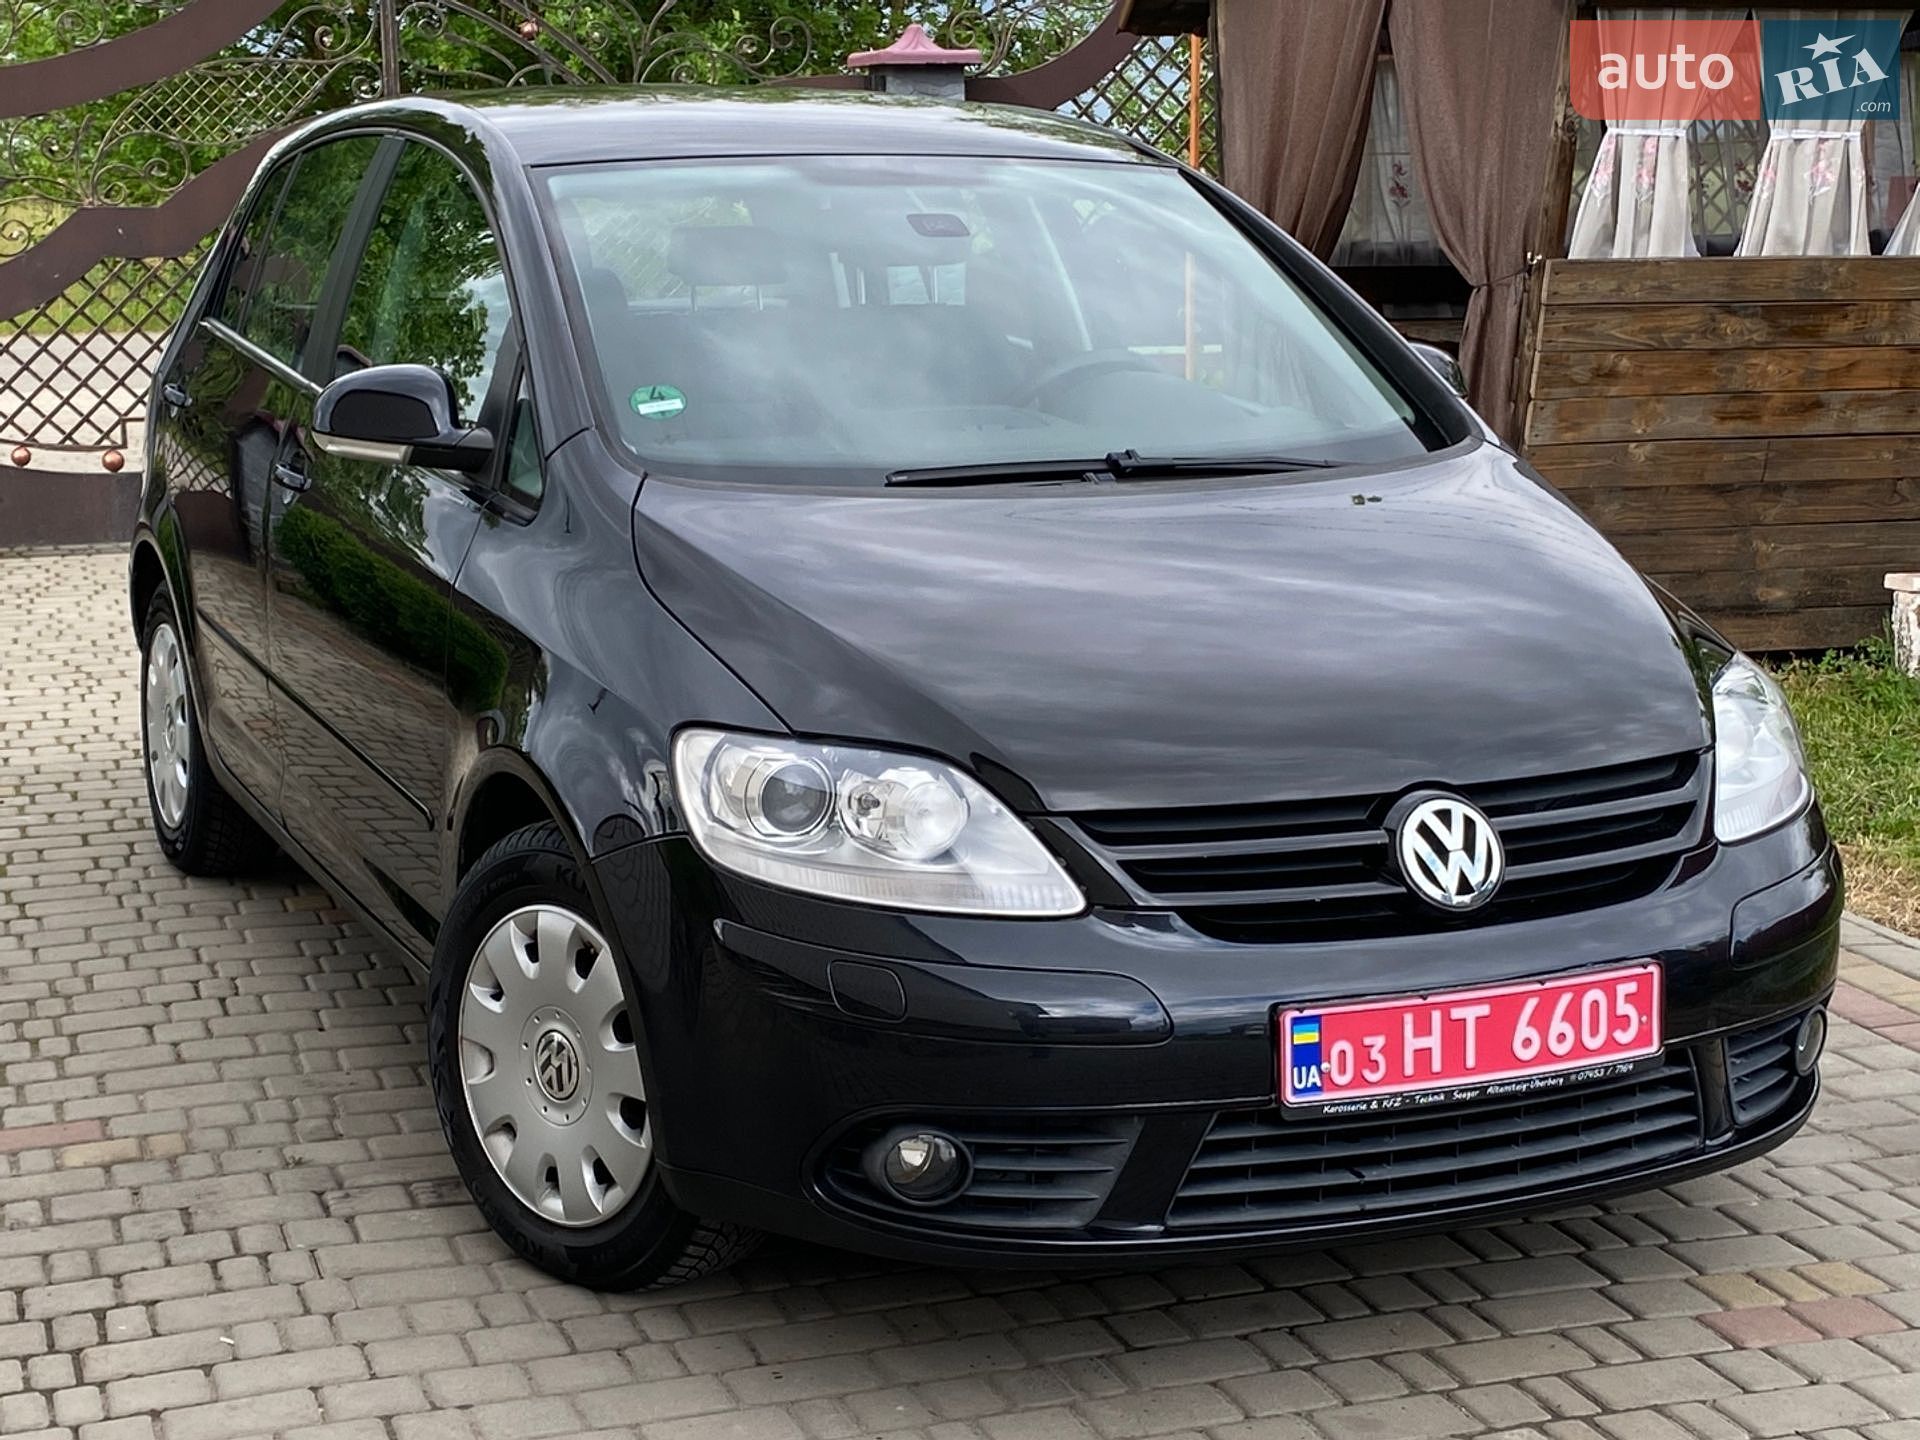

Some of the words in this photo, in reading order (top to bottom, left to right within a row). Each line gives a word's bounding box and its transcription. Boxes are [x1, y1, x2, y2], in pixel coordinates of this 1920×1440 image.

[1329, 1034, 1387, 1087] 03
[1402, 1003, 1492, 1078] HT
[1511, 980, 1640, 1063] 6605
[1293, 1066, 1322, 1091] UA
[1370, 1099, 1379, 1110] &
[1415, 1092, 1445, 1104] Technik
